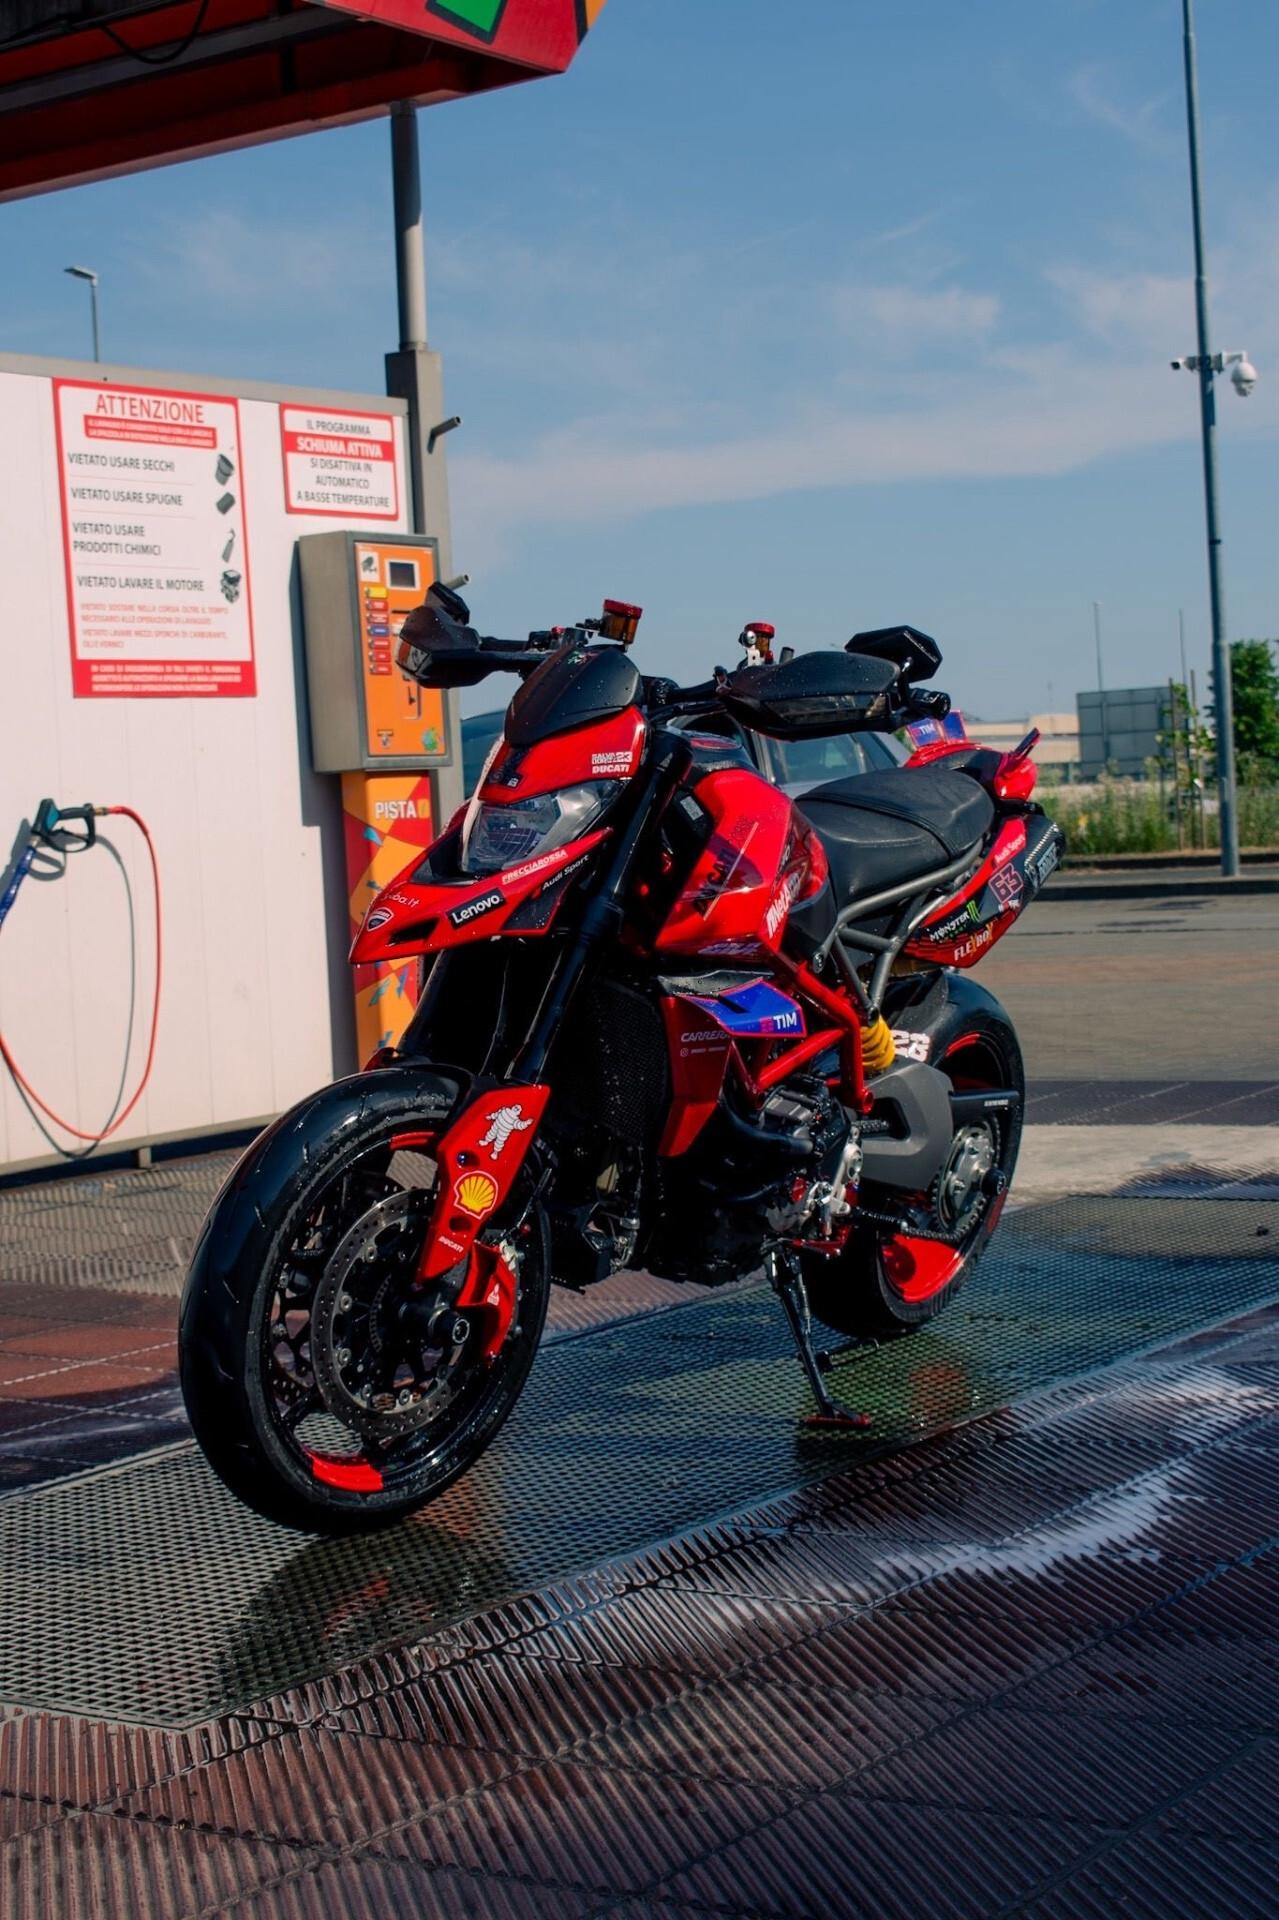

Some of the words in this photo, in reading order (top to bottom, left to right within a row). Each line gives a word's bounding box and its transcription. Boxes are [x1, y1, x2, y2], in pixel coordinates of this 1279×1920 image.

[96, 394, 205, 424] ATTENZIONE
[307, 420, 315, 430] IL
[316, 420, 371, 435] PROGRAMMA
[297, 436, 346, 454] SCHIUMA
[347, 441, 383, 458] ATTIVA
[68, 453, 107, 467] VIETATO
[110, 456, 140, 470] USARE
[143, 459, 175, 472] SECCHI
[310, 458, 318, 468] SI
[320, 459, 361, 472] DISATTIVA
[364, 462, 373, 472] IN
[316, 475, 370, 489] AUTOMATICO
[71, 487, 110, 501] VIETATO
[113, 490, 143, 504] USARE
[145, 493, 183, 507] SPUGNE
[297, 490, 303, 500] A
[305, 491, 330, 503] BASSE
[331, 493, 389, 507] TEMPERATURE
[73, 522, 112, 535] VIETATO
[114, 524, 145, 537] USARE
[74, 541, 123, 554] PRODOTTI
[125, 543, 161, 556] CHIMICI
[77, 576, 117, 589] VIETATO
[119, 578, 154, 590] LAVARE
[155, 580, 164, 590] IL
[166, 580, 205, 592] MOTORE
[919, 723, 936, 735] TIM
[615, 751, 632, 763] 23
[592, 764, 630, 774] DUCATI
[375, 800, 417, 819] PISTA
[502, 849, 568, 885] FRECCIAROSSA
[542, 868, 563, 891] Audi
[563, 854, 590, 876] Sport
[452, 894, 501, 924] Lenovo
[929, 911, 970, 942] MONSTER
[773, 1012, 798, 1030] TIM
[681, 1030, 730, 1042] CARRER
